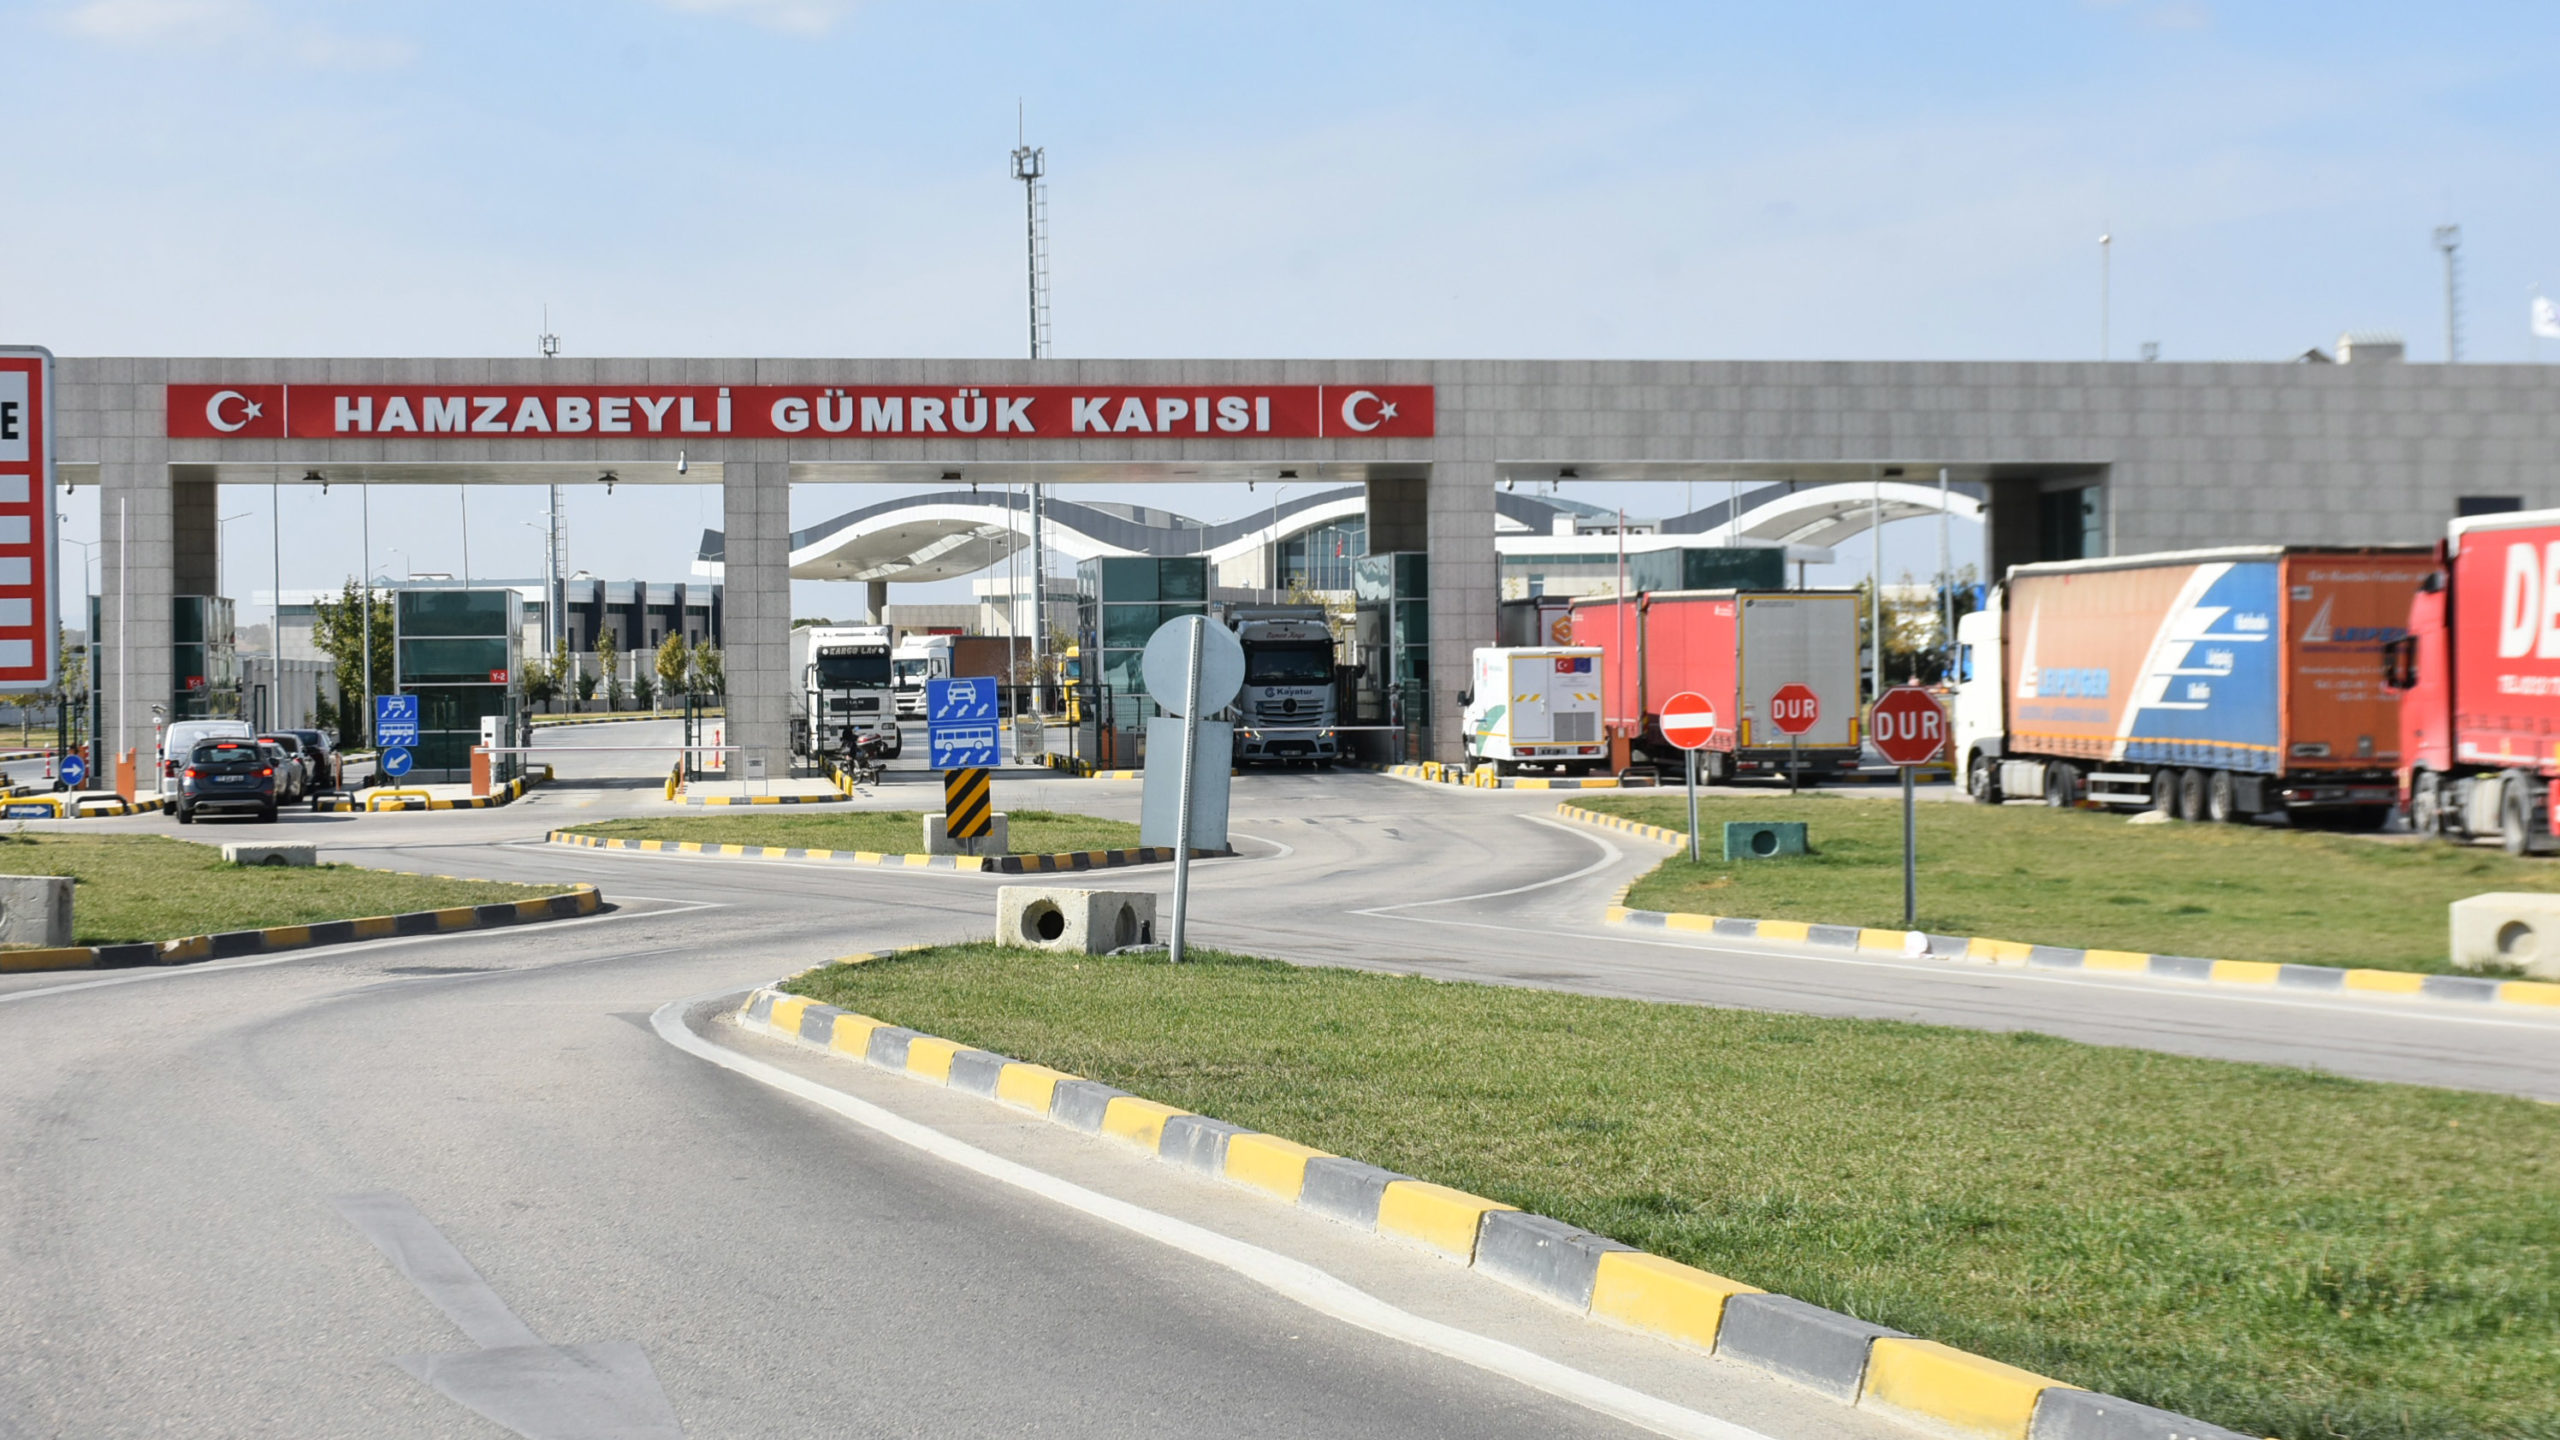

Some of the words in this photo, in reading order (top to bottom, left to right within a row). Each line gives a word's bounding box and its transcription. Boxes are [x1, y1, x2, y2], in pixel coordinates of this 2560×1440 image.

[334, 387, 732, 432] HAMZABEYLİ
[770, 388, 1035, 433] GÜMRÜK
[1072, 395, 1270, 433] KAPISI
[492, 672, 505, 681] Y-2
[1276, 687, 1313, 696] Kayatur
[1773, 698, 1816, 719] DUR
[1877, 711, 1940, 741] DUR
